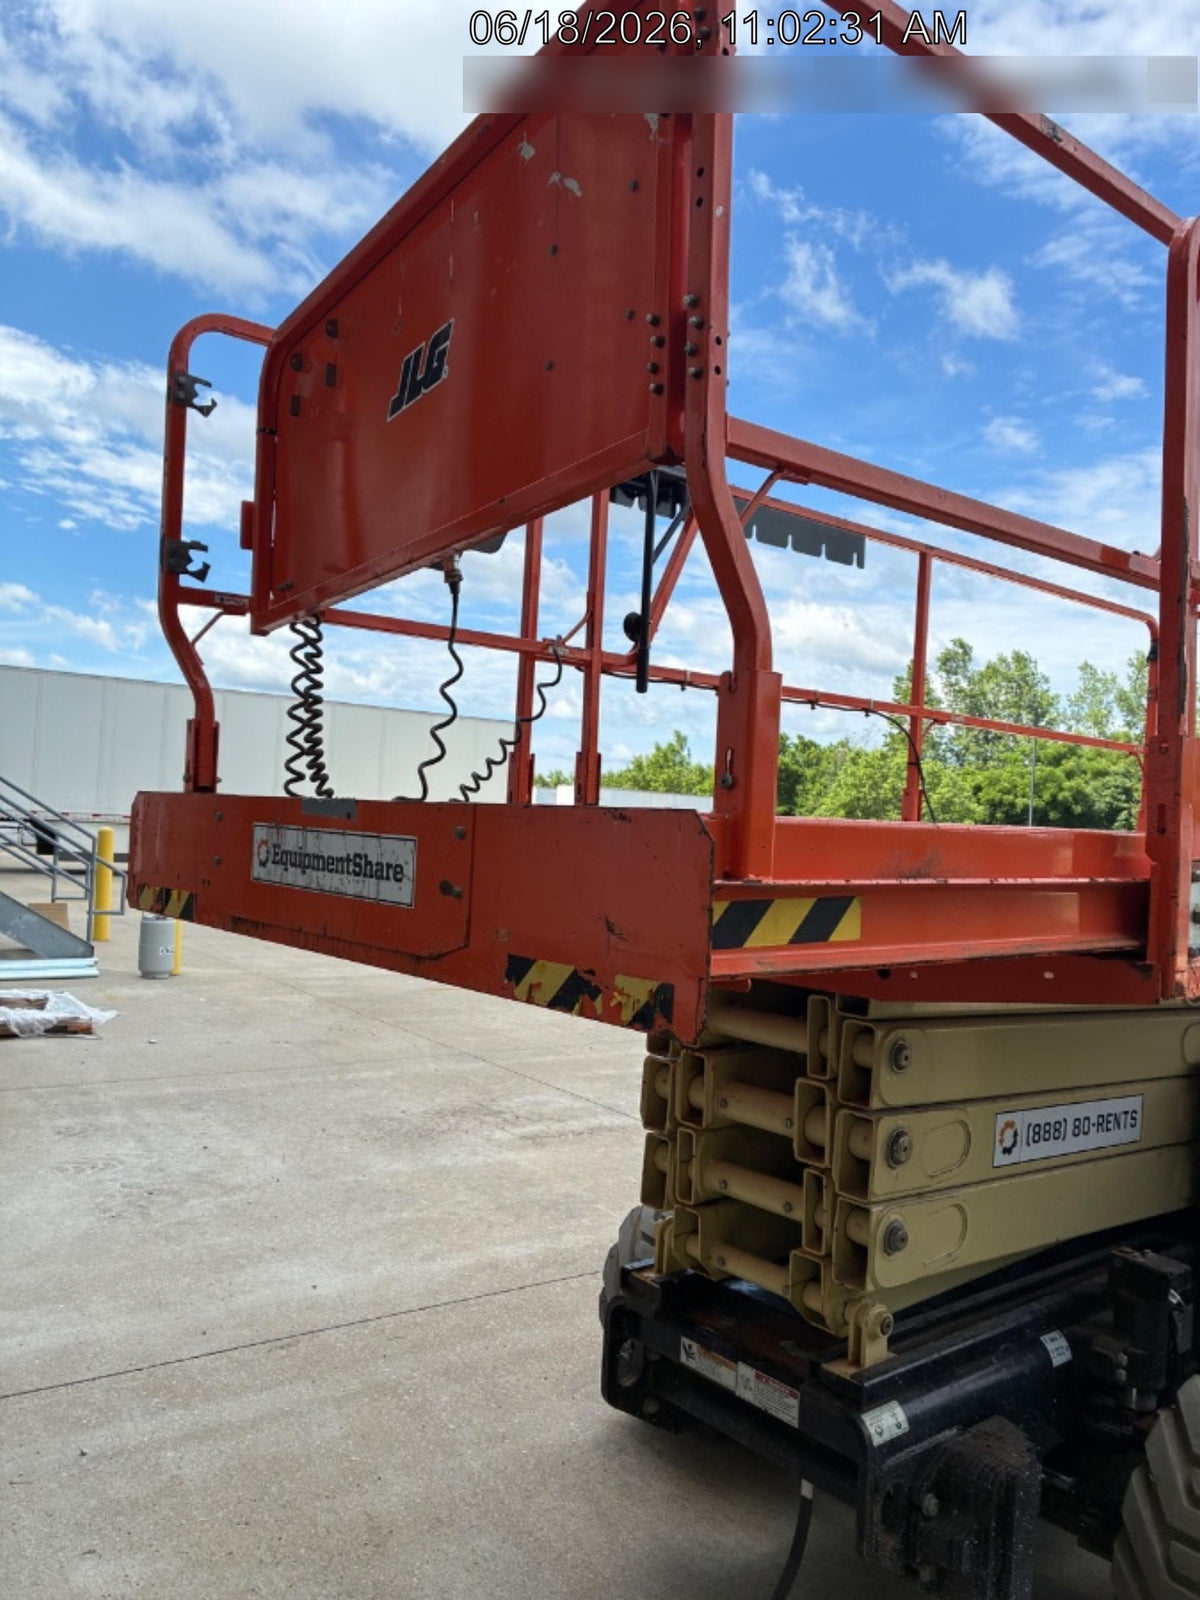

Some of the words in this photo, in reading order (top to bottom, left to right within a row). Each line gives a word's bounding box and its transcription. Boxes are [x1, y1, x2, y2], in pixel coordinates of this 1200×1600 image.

[387, 318, 454, 422] JLG
[271, 843, 404, 882] EquipmentShare
[1026, 1117, 1067, 1146] (888)
[1071, 1109, 1138, 1138] 80-RENTS
